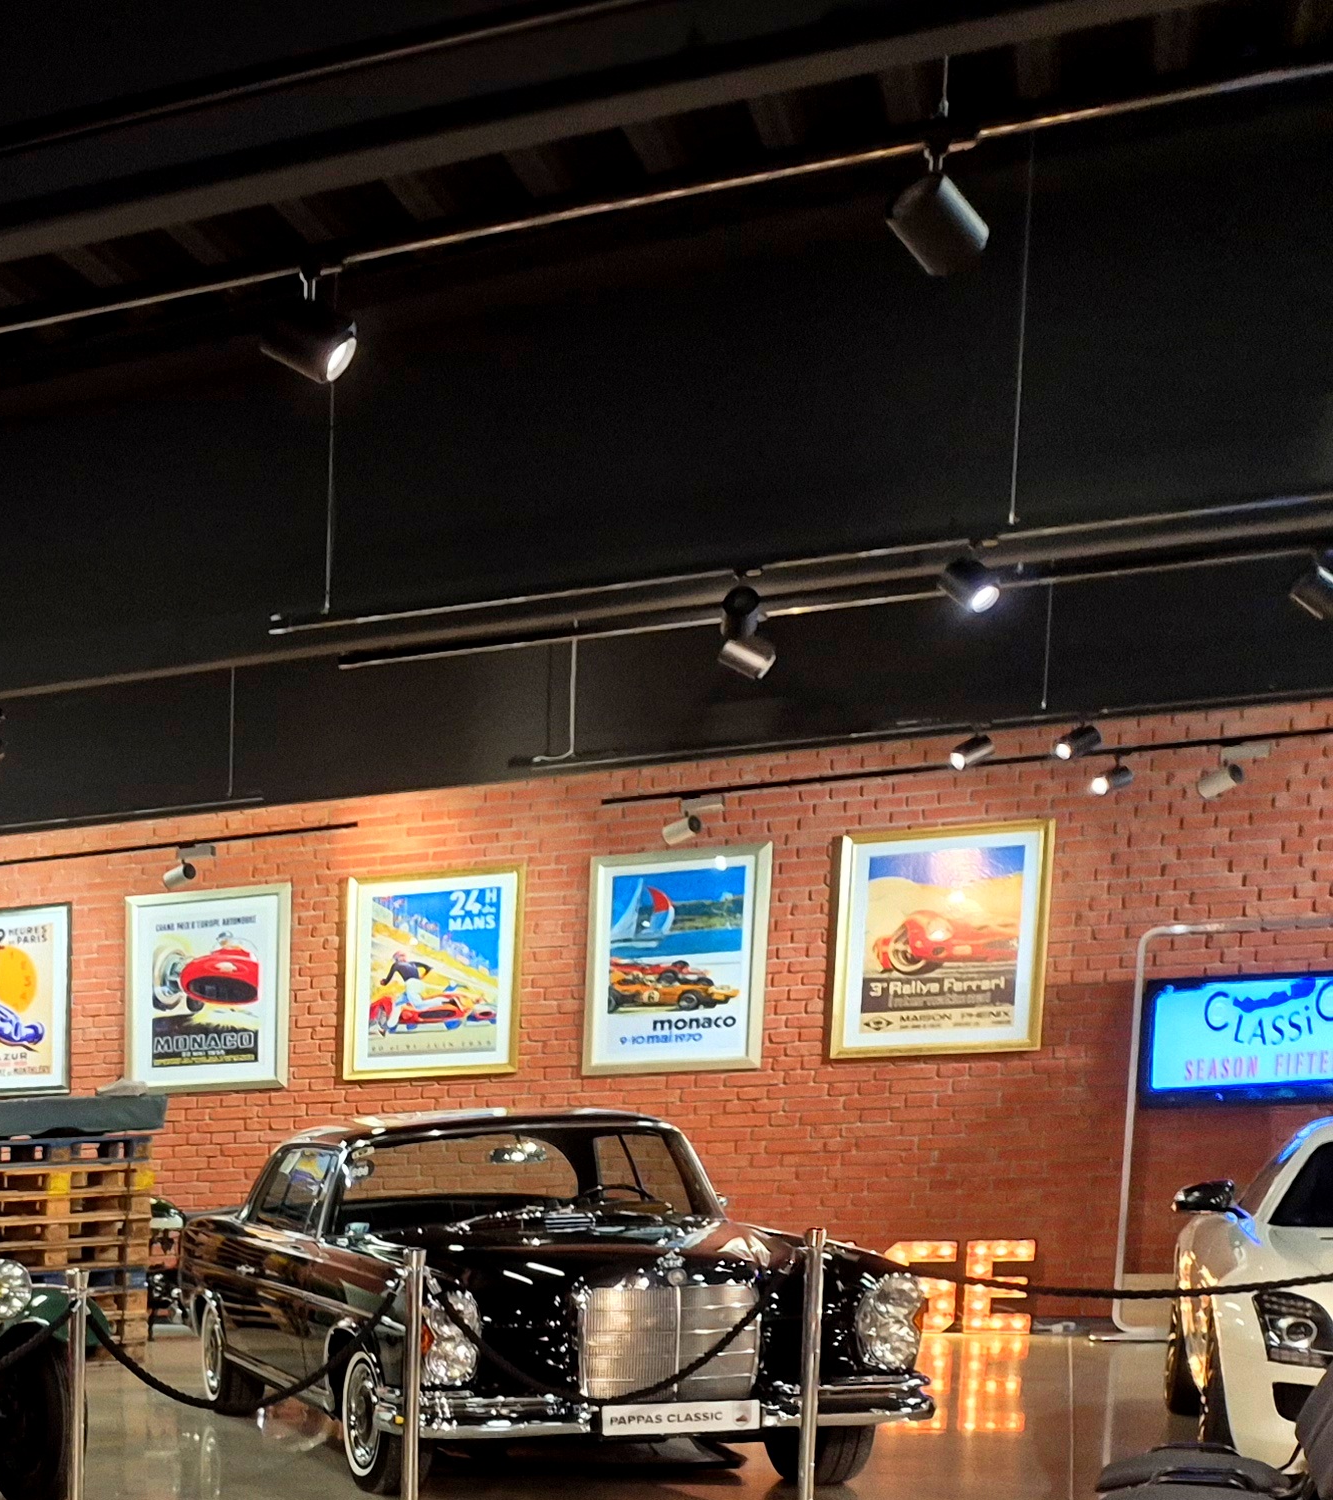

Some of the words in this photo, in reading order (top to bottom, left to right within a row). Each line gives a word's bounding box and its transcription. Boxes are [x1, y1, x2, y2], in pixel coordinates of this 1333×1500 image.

[449, 889, 483, 916] 24
[485, 887, 497, 903] H
[448, 915, 496, 931] MANS
[17, 934, 48, 944] PARIS
[889, 981, 940, 996] Rallye
[943, 976, 1006, 992] Ferrari
[652, 1015, 737, 1032] monaco
[153, 1031, 255, 1053] MONACO
[1184, 1055, 1259, 1081] SEASON
[609, 1413, 663, 1426] PAPPAS
[666, 1411, 724, 1424] CLASSIC
